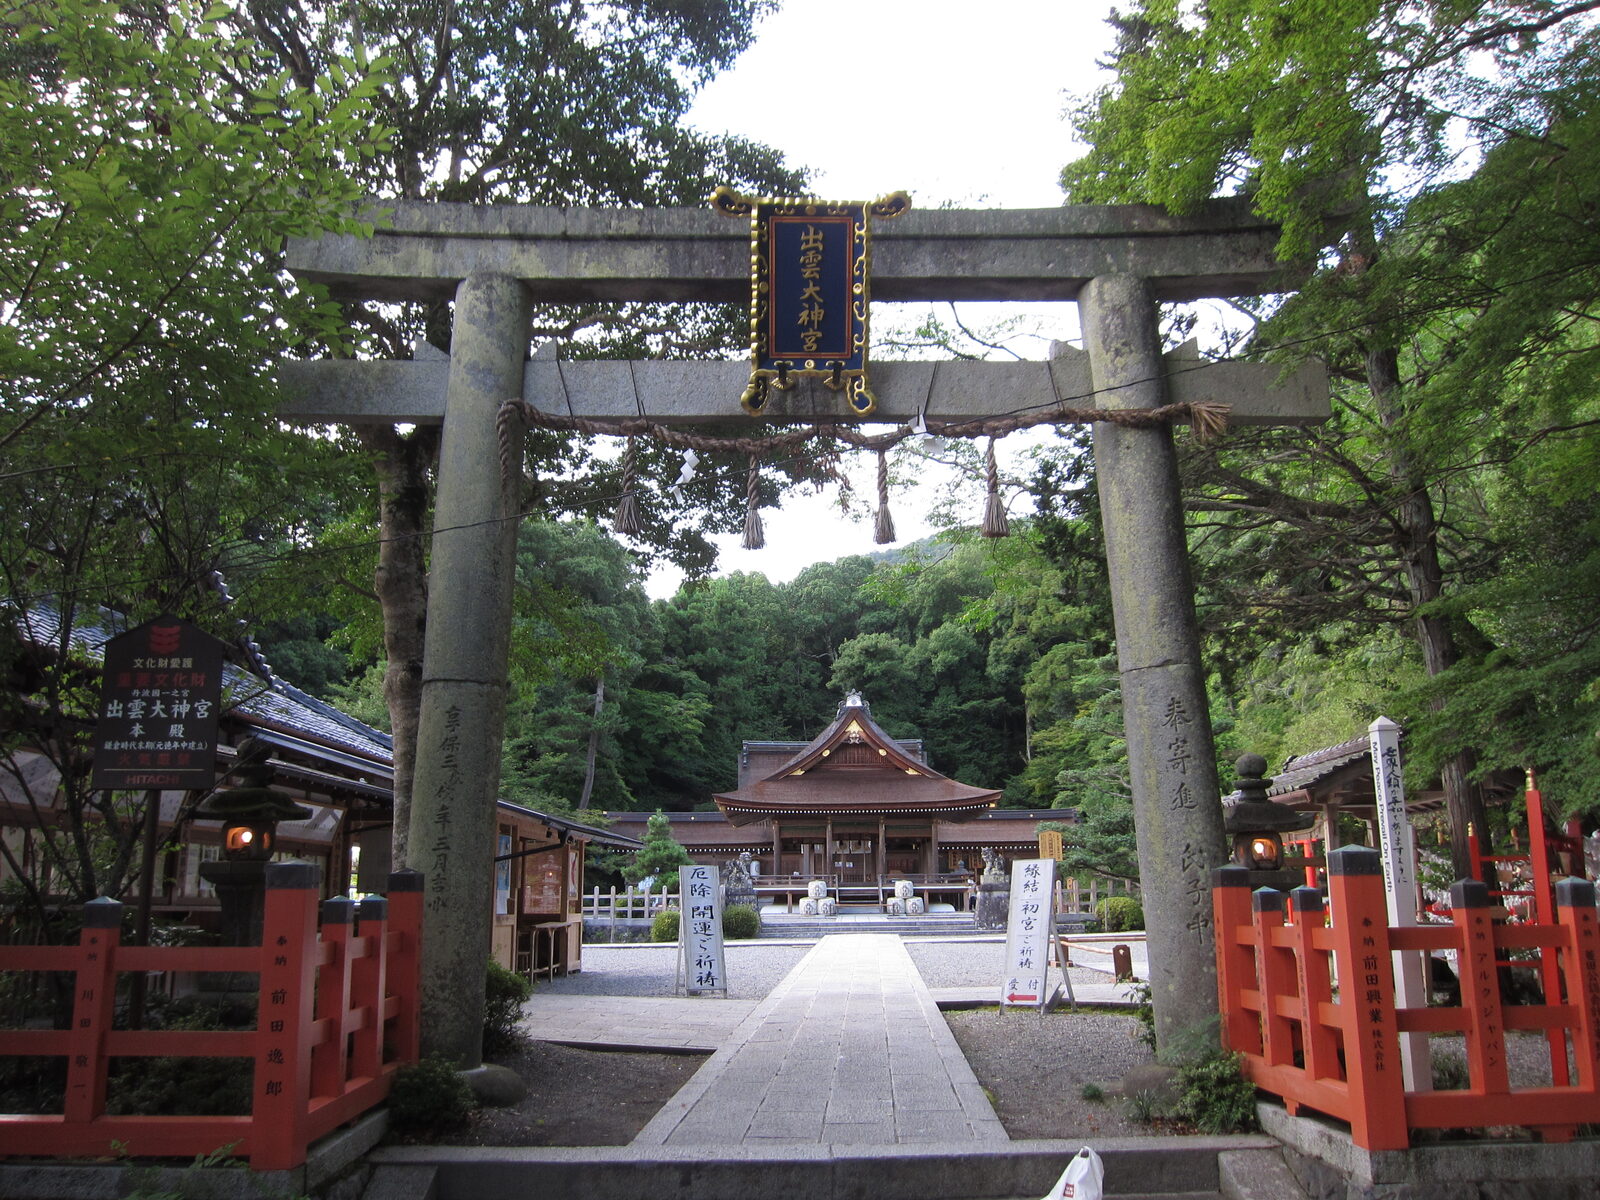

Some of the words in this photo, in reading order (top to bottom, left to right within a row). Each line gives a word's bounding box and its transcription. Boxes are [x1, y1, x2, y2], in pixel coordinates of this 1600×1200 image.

[797, 224, 825, 353] 出雲大神宮
[106, 698, 214, 720] 出雲大神宮
[129, 722, 186, 738] 本殿
[1371, 741, 1380, 765] May
[125, 775, 182, 785] HITACHI
[1374, 767, 1384, 802] Peace
[1378, 803, 1388, 840] Prevail
[1382, 746, 1408, 885] 世界人類が平和でありますように
[1382, 841, 1391, 859] On
[690, 866, 712, 898] 厄除
[1385, 861, 1394, 893] Earth
[1181, 843, 1210, 945] 氏子中
[691, 904, 718, 987] 開運ご祈祷
[1008, 978, 1039, 991] 受付
[1476, 952, 1498, 1067] アルクジャパン
